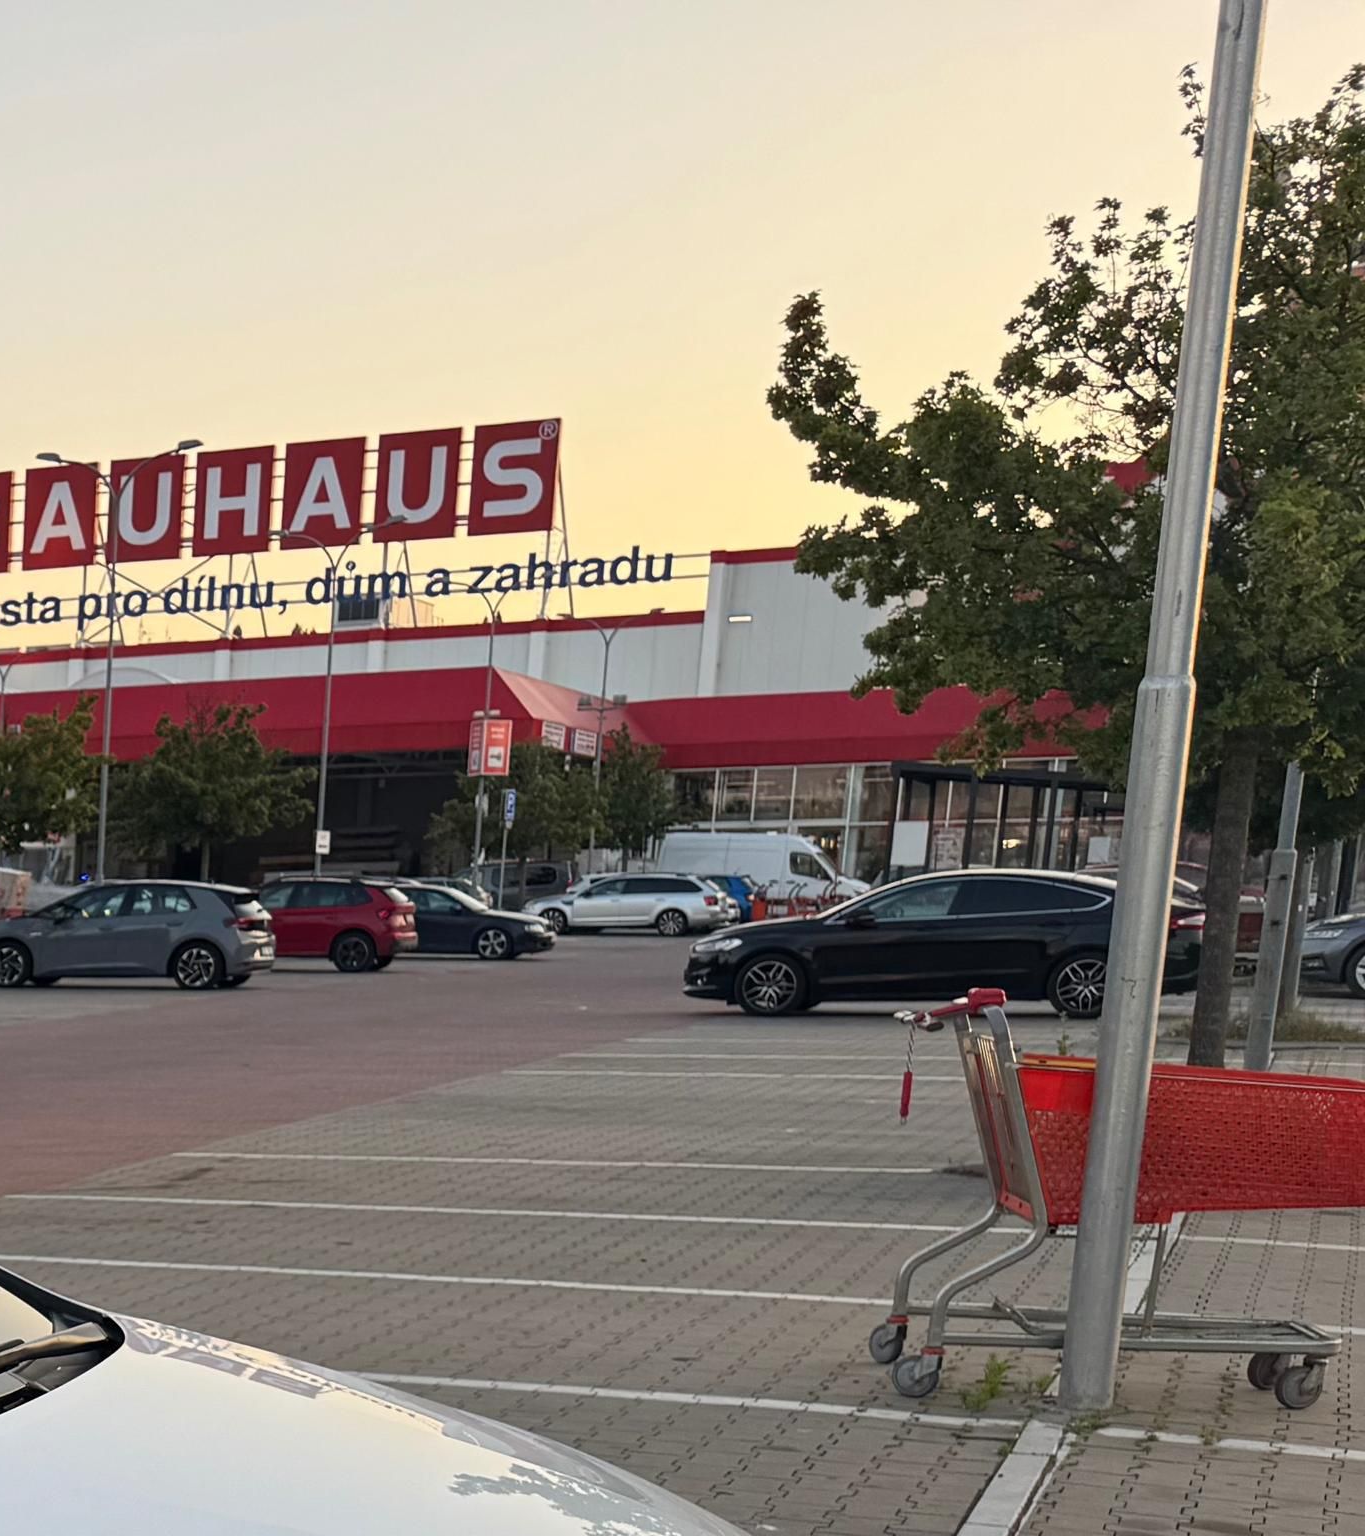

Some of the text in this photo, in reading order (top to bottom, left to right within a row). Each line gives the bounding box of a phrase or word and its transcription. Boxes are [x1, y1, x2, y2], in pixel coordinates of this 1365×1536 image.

[77, 591, 149, 632] pro
[164, 575, 287, 615] dílnu,
[306, 560, 408, 606] dům
[425, 566, 451, 597] a
[467, 545, 674, 595] zahradu
